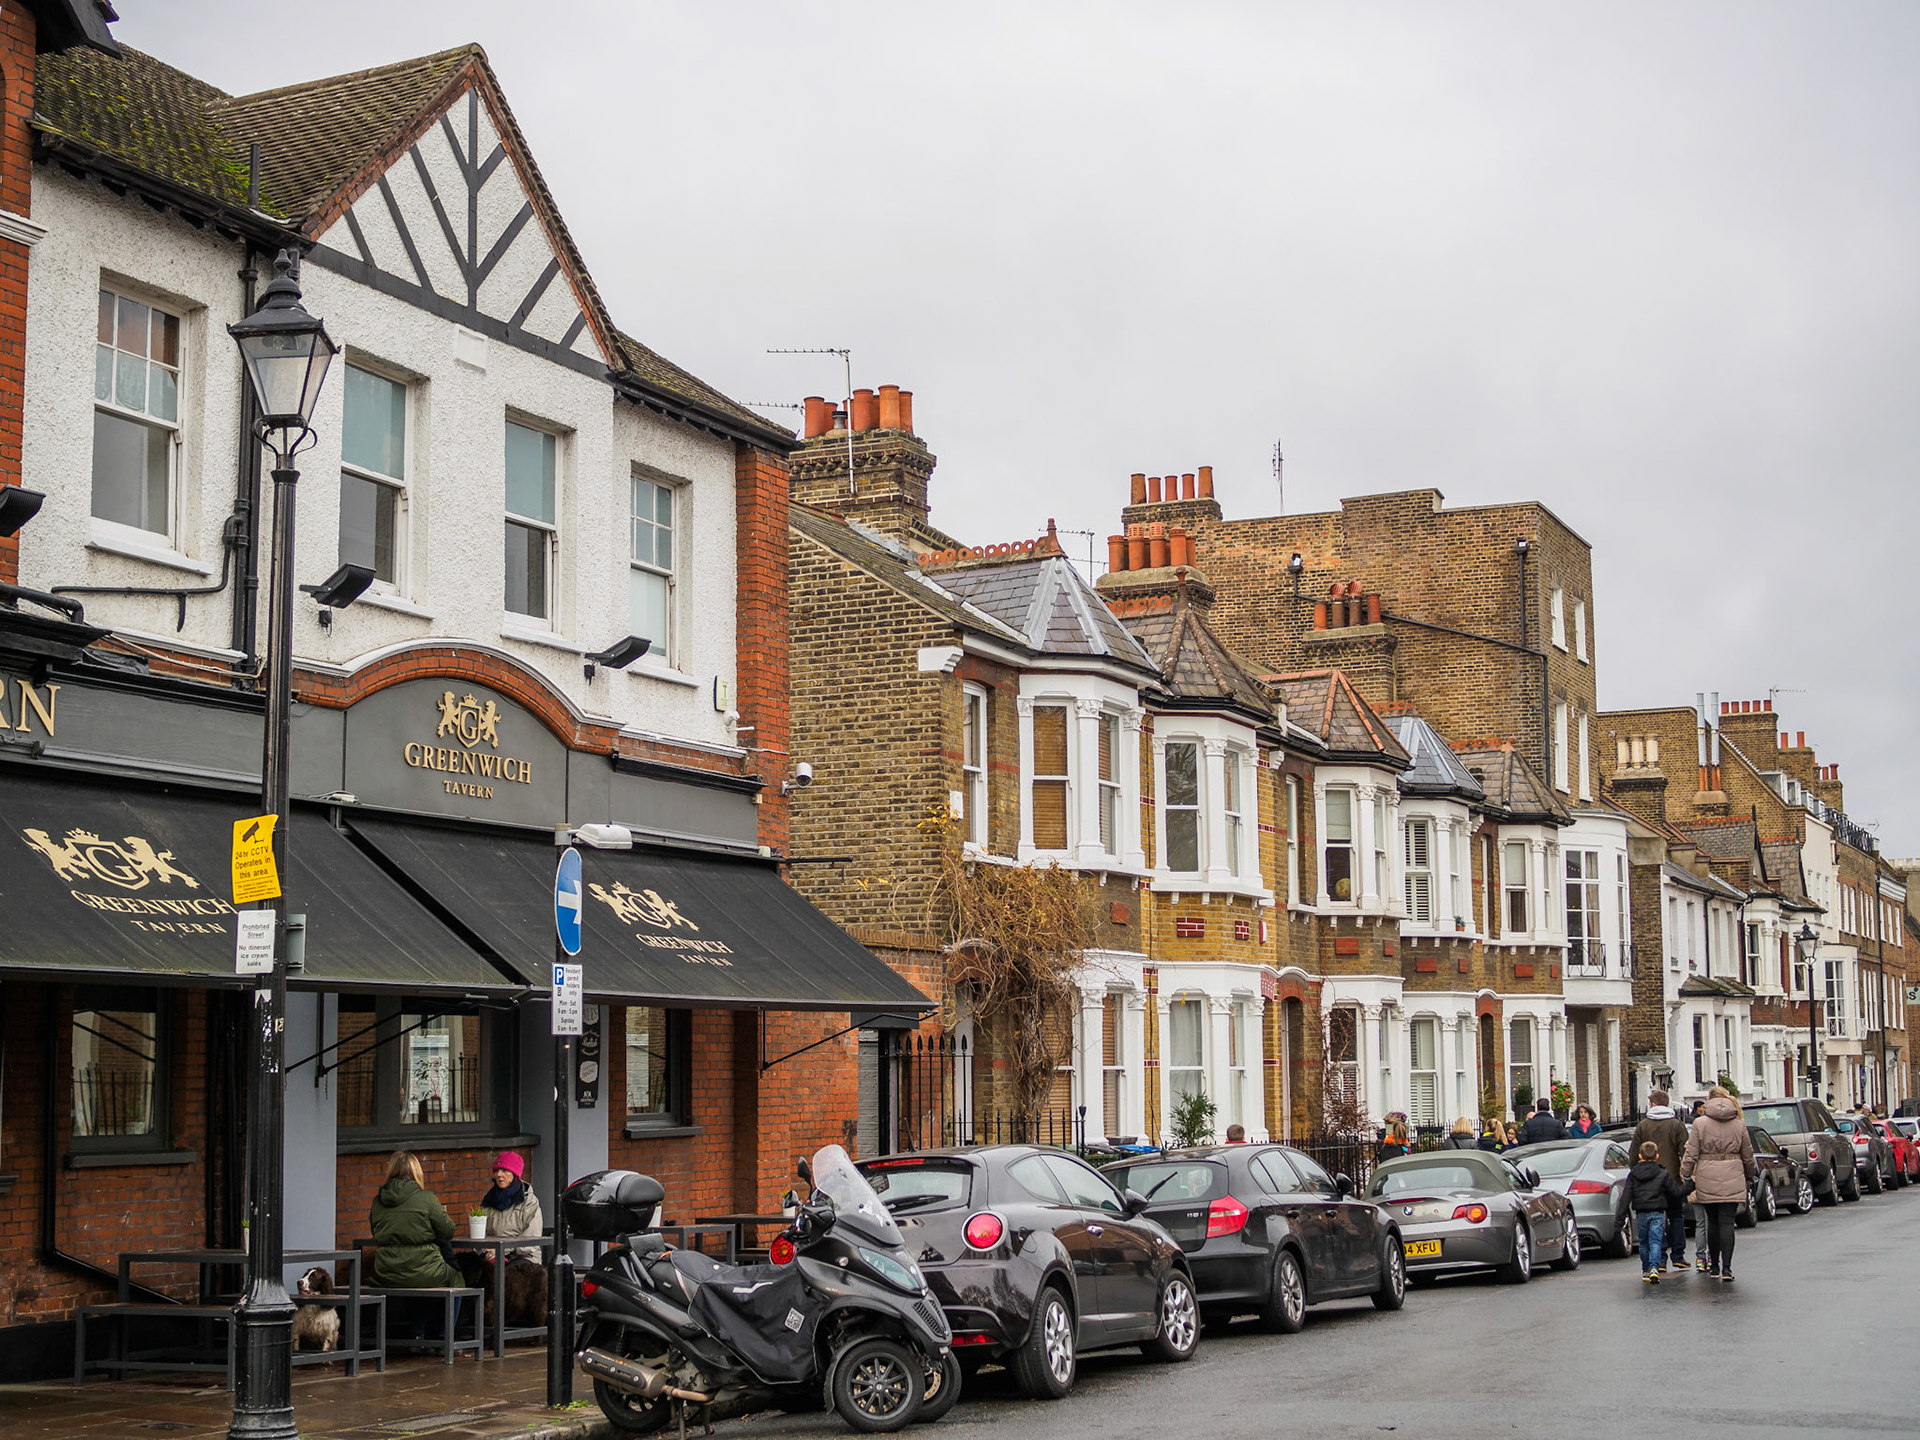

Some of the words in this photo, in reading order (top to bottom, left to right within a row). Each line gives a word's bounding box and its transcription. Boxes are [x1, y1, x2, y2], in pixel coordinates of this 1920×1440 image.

[0, 679, 61, 736] N
[460, 709, 478, 739] G
[404, 741, 533, 784] GREENWICH
[443, 780, 494, 799] TAVERN
[250, 845, 269, 857] CCTV
[85, 846, 139, 881] G
[234, 859, 263, 870] Operates
[264, 856, 271, 864] in
[239, 870, 251, 879] this
[253, 868, 268, 877] area
[70, 889, 239, 916] GREENWICH
[627, 895, 663, 922] G
[130, 919, 228, 934] TAVERN
[635, 933, 735, 954] GREENWICH
[556, 968, 564, 984] P
[1416, 1242, 1436, 1254] XFU
